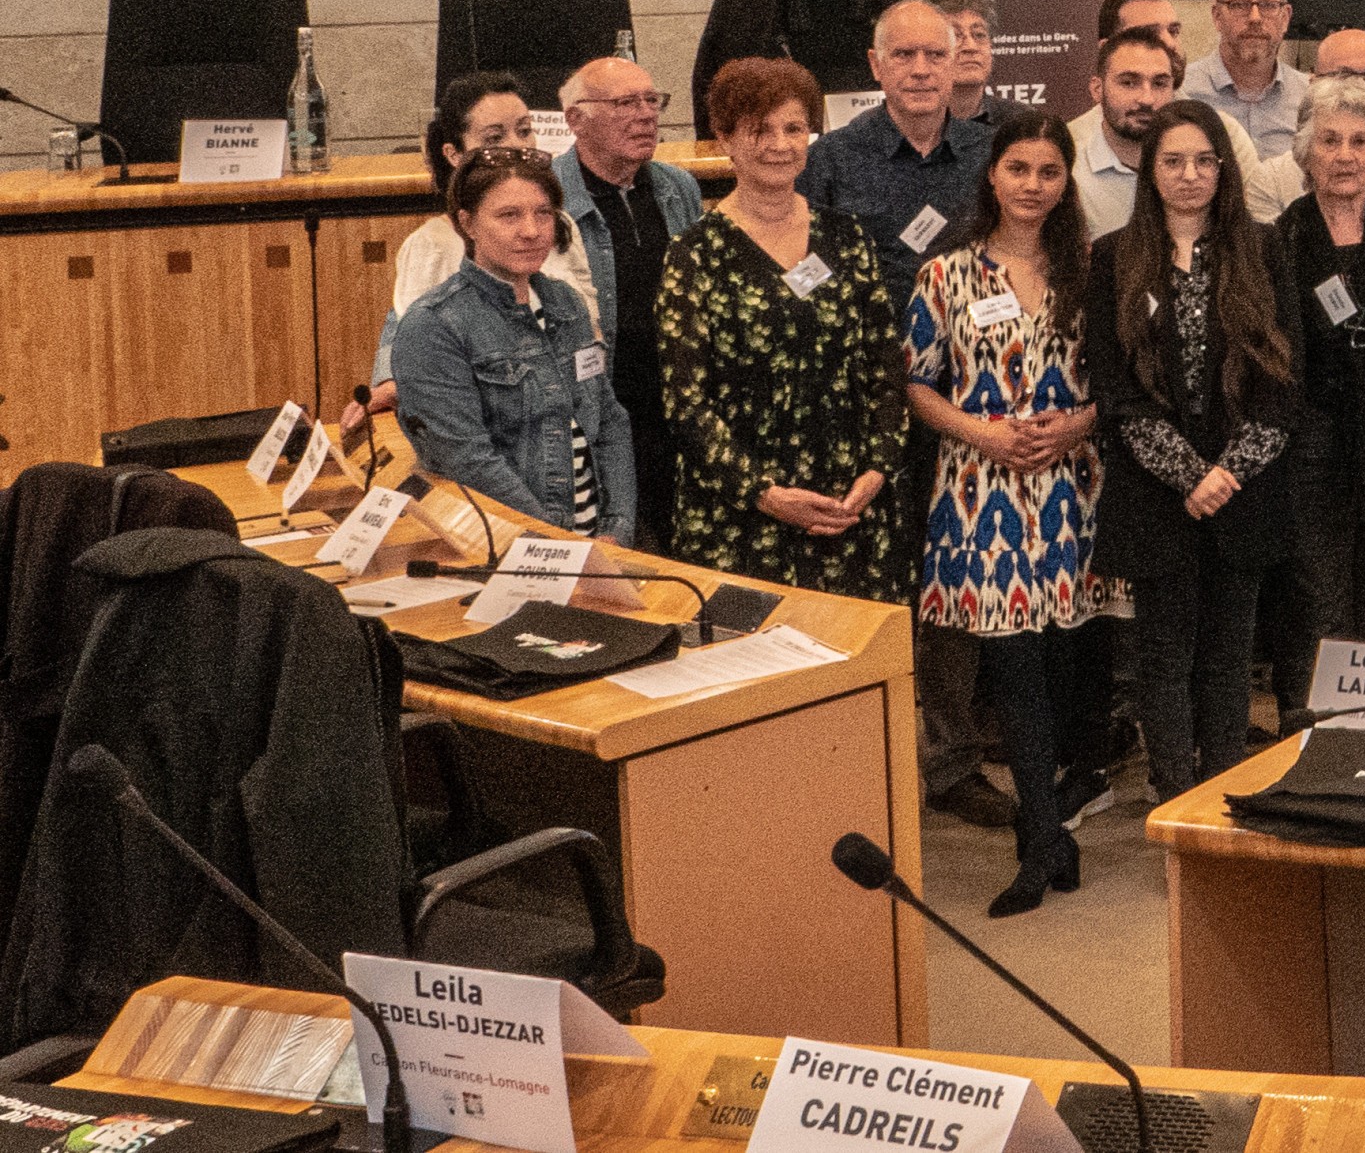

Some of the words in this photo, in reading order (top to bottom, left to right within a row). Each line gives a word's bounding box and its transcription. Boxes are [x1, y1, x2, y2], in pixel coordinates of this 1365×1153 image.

[1017, 33, 1037, 42] dans
[1042, 33, 1051, 42] le
[1017, 44, 1061, 55] territoire
[213, 124, 254, 134] Hervé
[206, 138, 259, 149] BIANNE
[524, 544, 570, 561] Morgane
[414, 970, 483, 1006] Leila
[371, 1001, 545, 1045] EDELSI-DJEZZAR
[372, 1053, 417, 1071] Caon
[419, 1060, 550, 1095] Fleurance-Lomagne
[789, 1048, 879, 1088] Pierre
[886, 1066, 1005, 1110] Clément
[800, 1098, 964, 1152] CADREILS
